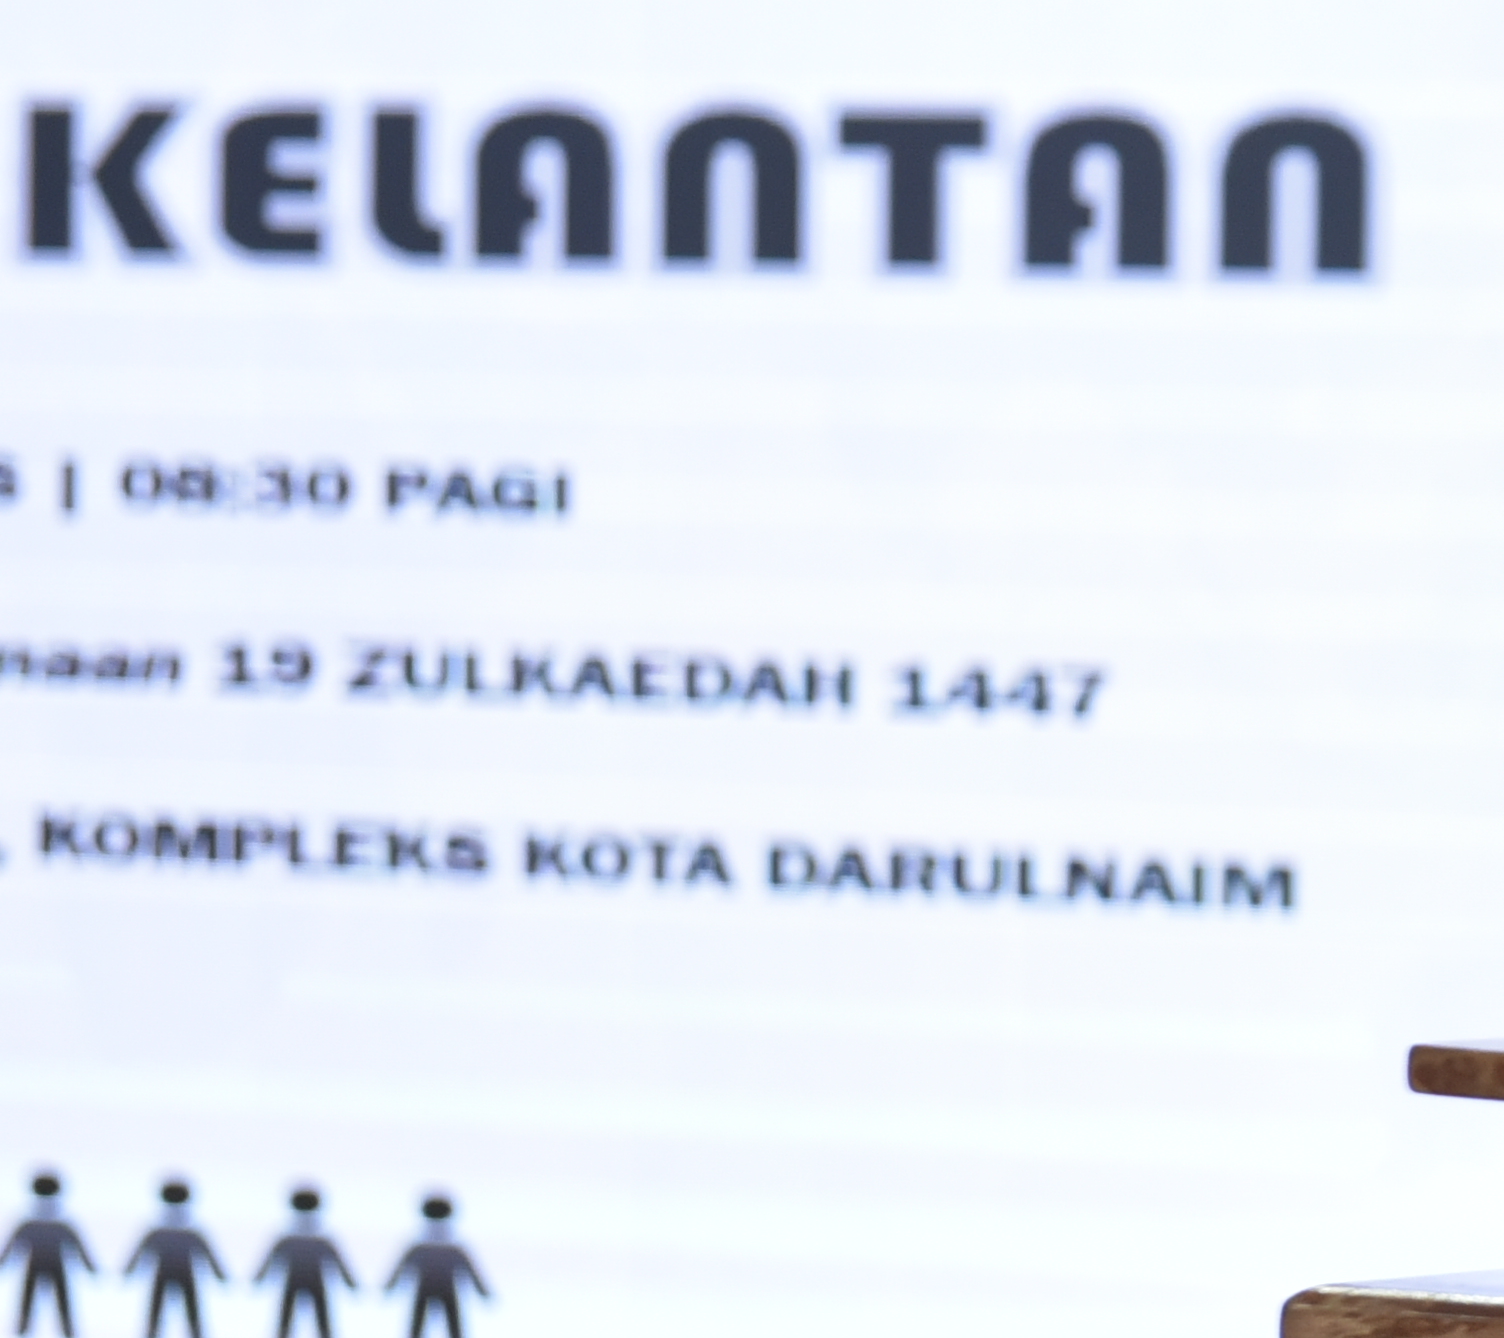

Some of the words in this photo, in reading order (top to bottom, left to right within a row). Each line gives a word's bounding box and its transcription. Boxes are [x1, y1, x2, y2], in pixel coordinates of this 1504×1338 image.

[27, 106, 1367, 274] KELANTAN
[119, 462, 353, 511] 08:30
[384, 467, 570, 516] PAGI
[222, 643, 316, 690] 19
[347, 645, 854, 708] ZULKAEDAH
[900, 666, 1102, 718] 1447
[37, 812, 490, 877] KOMPLEKS
[523, 833, 732, 887] KOTA
[767, 843, 1295, 910] DARULNAIM
